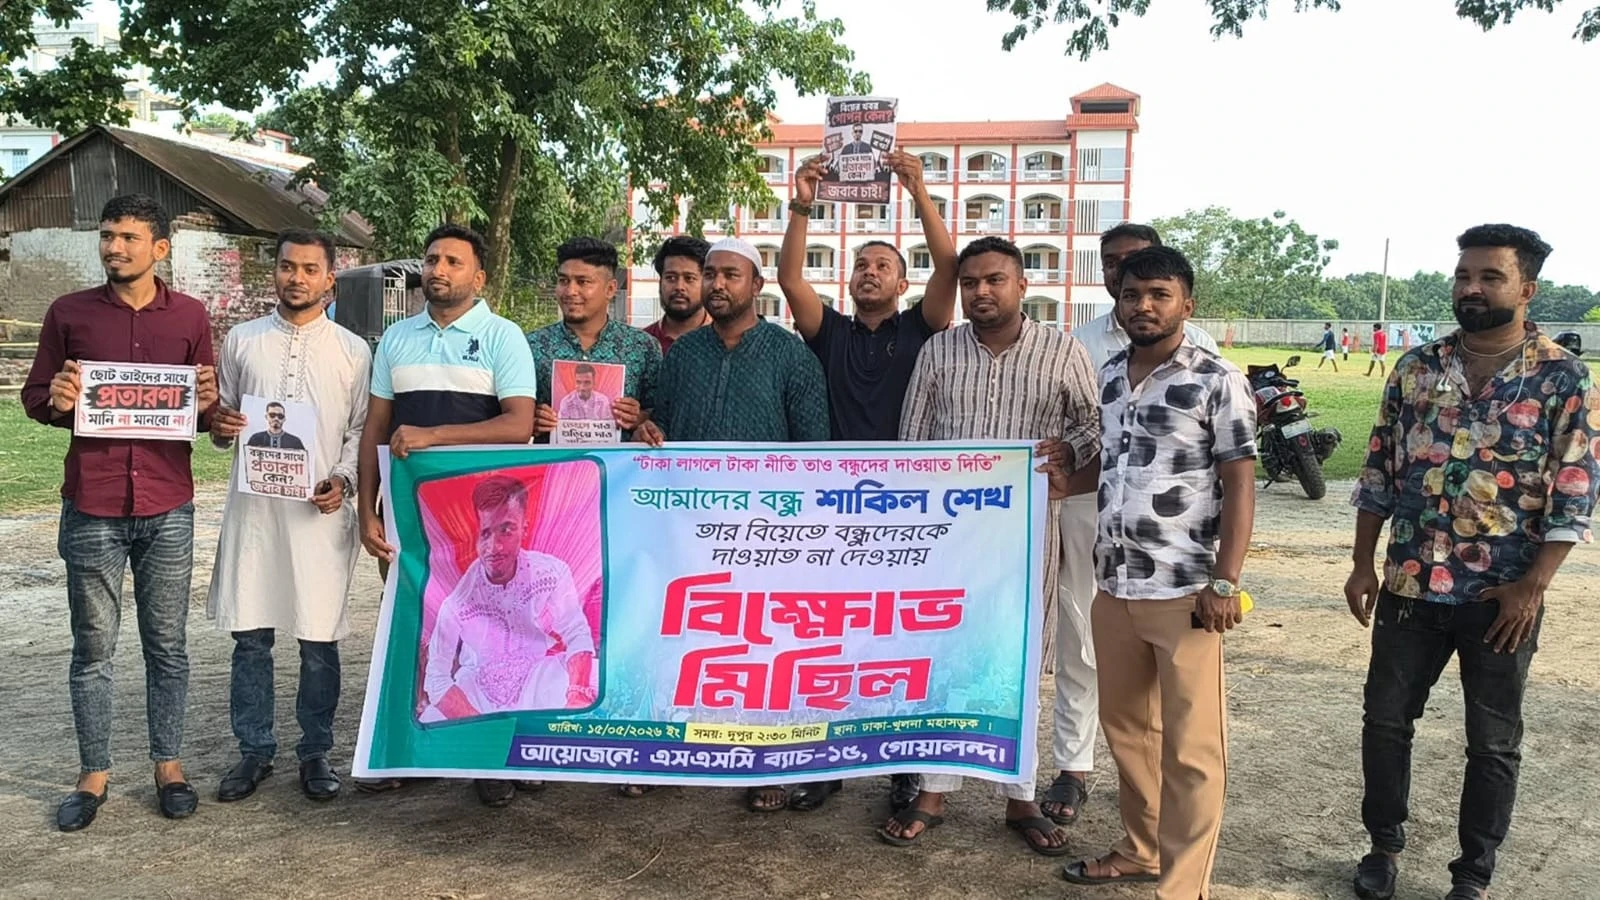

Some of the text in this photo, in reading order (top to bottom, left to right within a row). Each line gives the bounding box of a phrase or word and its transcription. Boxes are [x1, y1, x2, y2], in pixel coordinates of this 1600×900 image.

[864, 110, 892, 122] কেন?
[828, 184, 882, 198] জবাব চাই!
[90, 368, 188, 384] ছোট ভাইদের সাথে
[96, 385, 183, 409] প্রতারণা
[89, 411, 186, 427] মানি না মানবো না
[249, 449, 305, 462] বন্ধুদের সাথে
[251, 460, 304, 475] প্রতারণা
[633, 453, 1001, 477] “টাকা লাগলে টাকা নীতি তাও বন্ধুদের দাওয়াত দিতি”
[263, 473, 294, 484] কেন?
[631, 479, 1013, 518] আমাদের বন্ধু শাকিল শেখ
[695, 518, 952, 547] তার বিয়েতে বন্ধুদেরকে
[711, 546, 931, 568] দাওয়াত না দেওয়ায়
[660, 571, 966, 645] বিক্ষোভ
[673, 643, 932, 712] মিছিল
[587, 723, 663, 738] ১৫/০৫/২০২৬
[666, 724, 680, 739] ইং
[861, 718, 922, 733] ঢাকা-খুলনা
[926, 717, 980, 730] মহাসড়ক
[727, 729, 753, 743] দুপুর
[791, 725, 821, 738] মিনিট
[650, 746, 756, 769] এসএসসি
[763, 746, 868, 769] ব্যাচ-১৫,
[879, 738, 1006, 764] গোয়ালন্দ।
